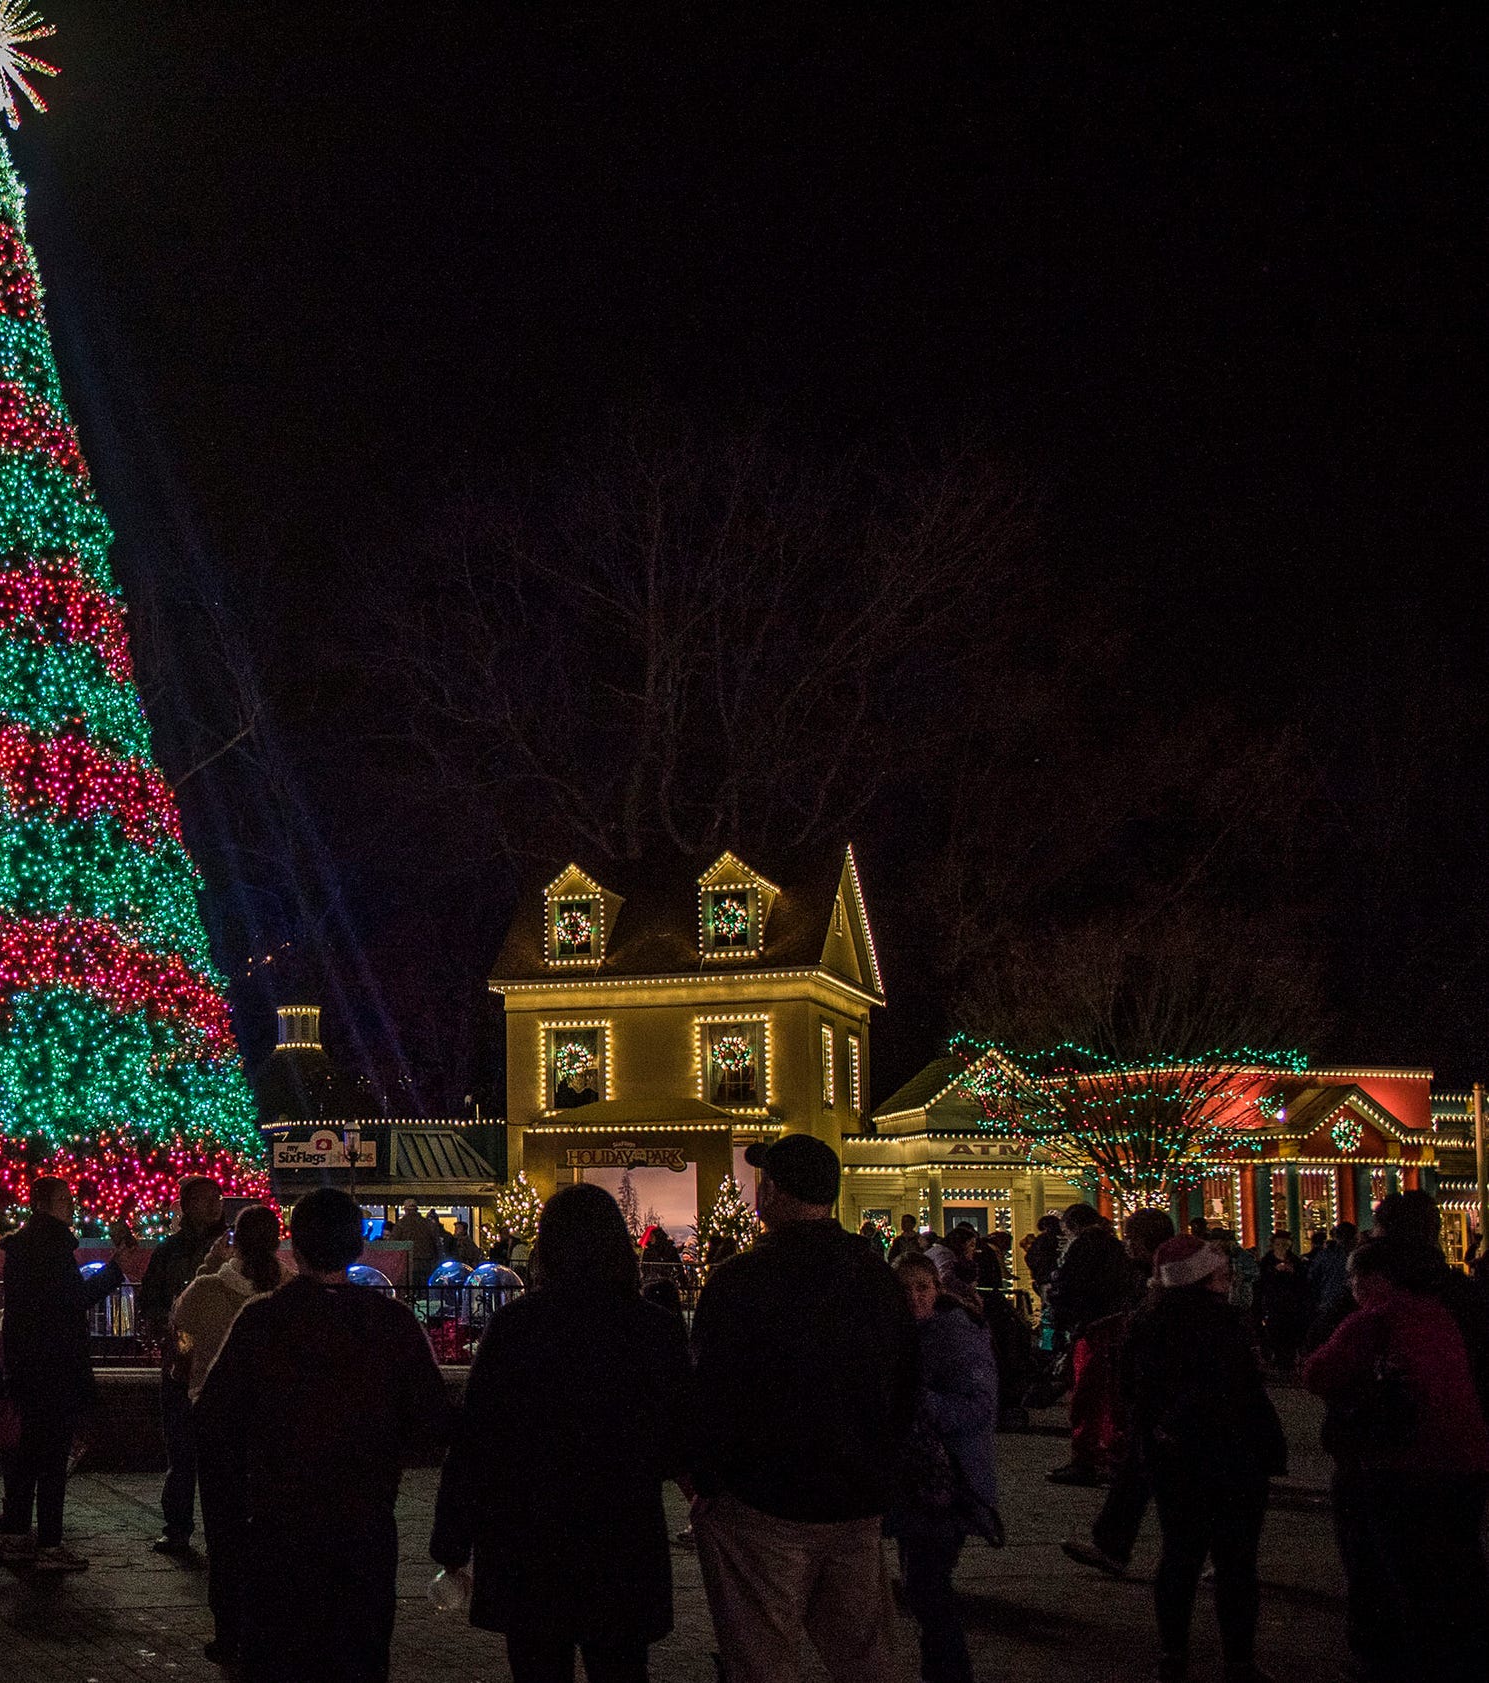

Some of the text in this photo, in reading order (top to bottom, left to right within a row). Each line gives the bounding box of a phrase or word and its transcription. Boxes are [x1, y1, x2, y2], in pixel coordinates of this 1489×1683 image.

[286, 1145, 299, 1153] my
[948, 1144, 1030, 1155] ATM
[278, 1151, 326, 1165] SixFlags
[568, 1149, 634, 1166] HOLIDAY
[646, 1149, 682, 1167] PARK
